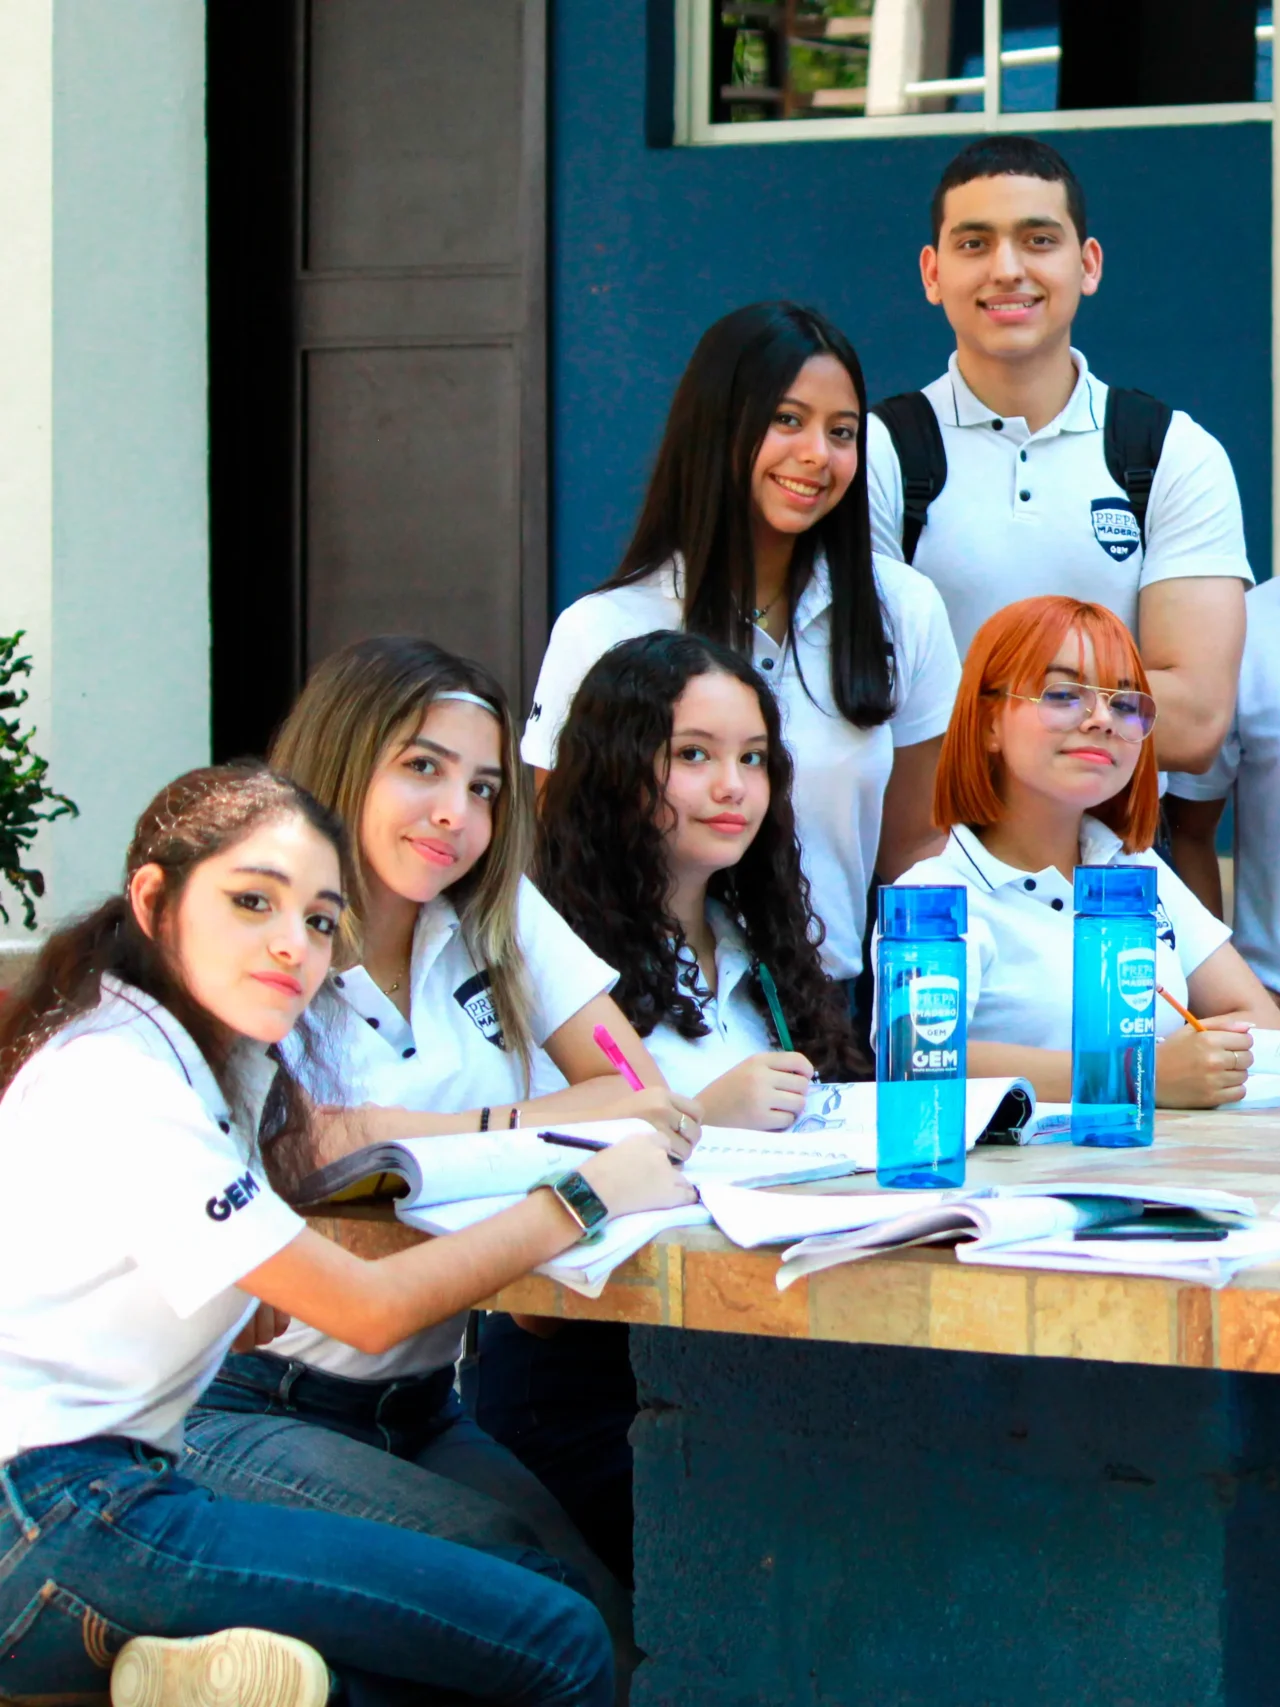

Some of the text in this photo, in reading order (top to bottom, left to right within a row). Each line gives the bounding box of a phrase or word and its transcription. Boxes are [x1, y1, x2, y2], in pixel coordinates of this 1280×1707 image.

[1095, 512, 1138, 528] PREPA
[1097, 526, 1138, 537] MADERO
[1110, 545, 1129, 555] GEM
[1120, 1017, 1154, 1034] GEM
[912, 1050, 958, 1068] GEM
[206, 1170, 260, 1221] GEM
